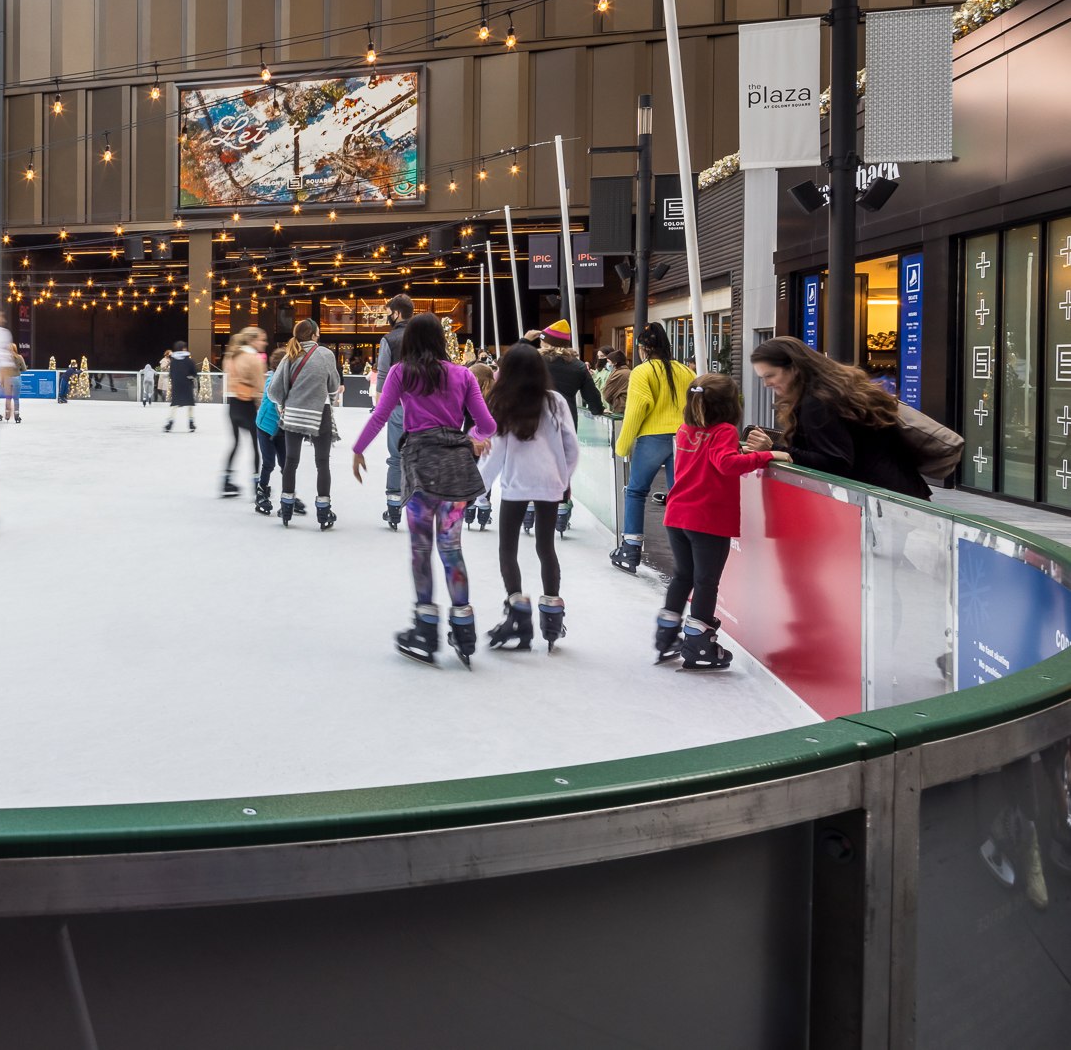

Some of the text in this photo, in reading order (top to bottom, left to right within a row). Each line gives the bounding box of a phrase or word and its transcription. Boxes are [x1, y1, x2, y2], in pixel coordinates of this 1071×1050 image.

[748, 86, 811, 108] plaza
[210, 116, 269, 149] Let
[533, 254, 551, 262] IPIC
